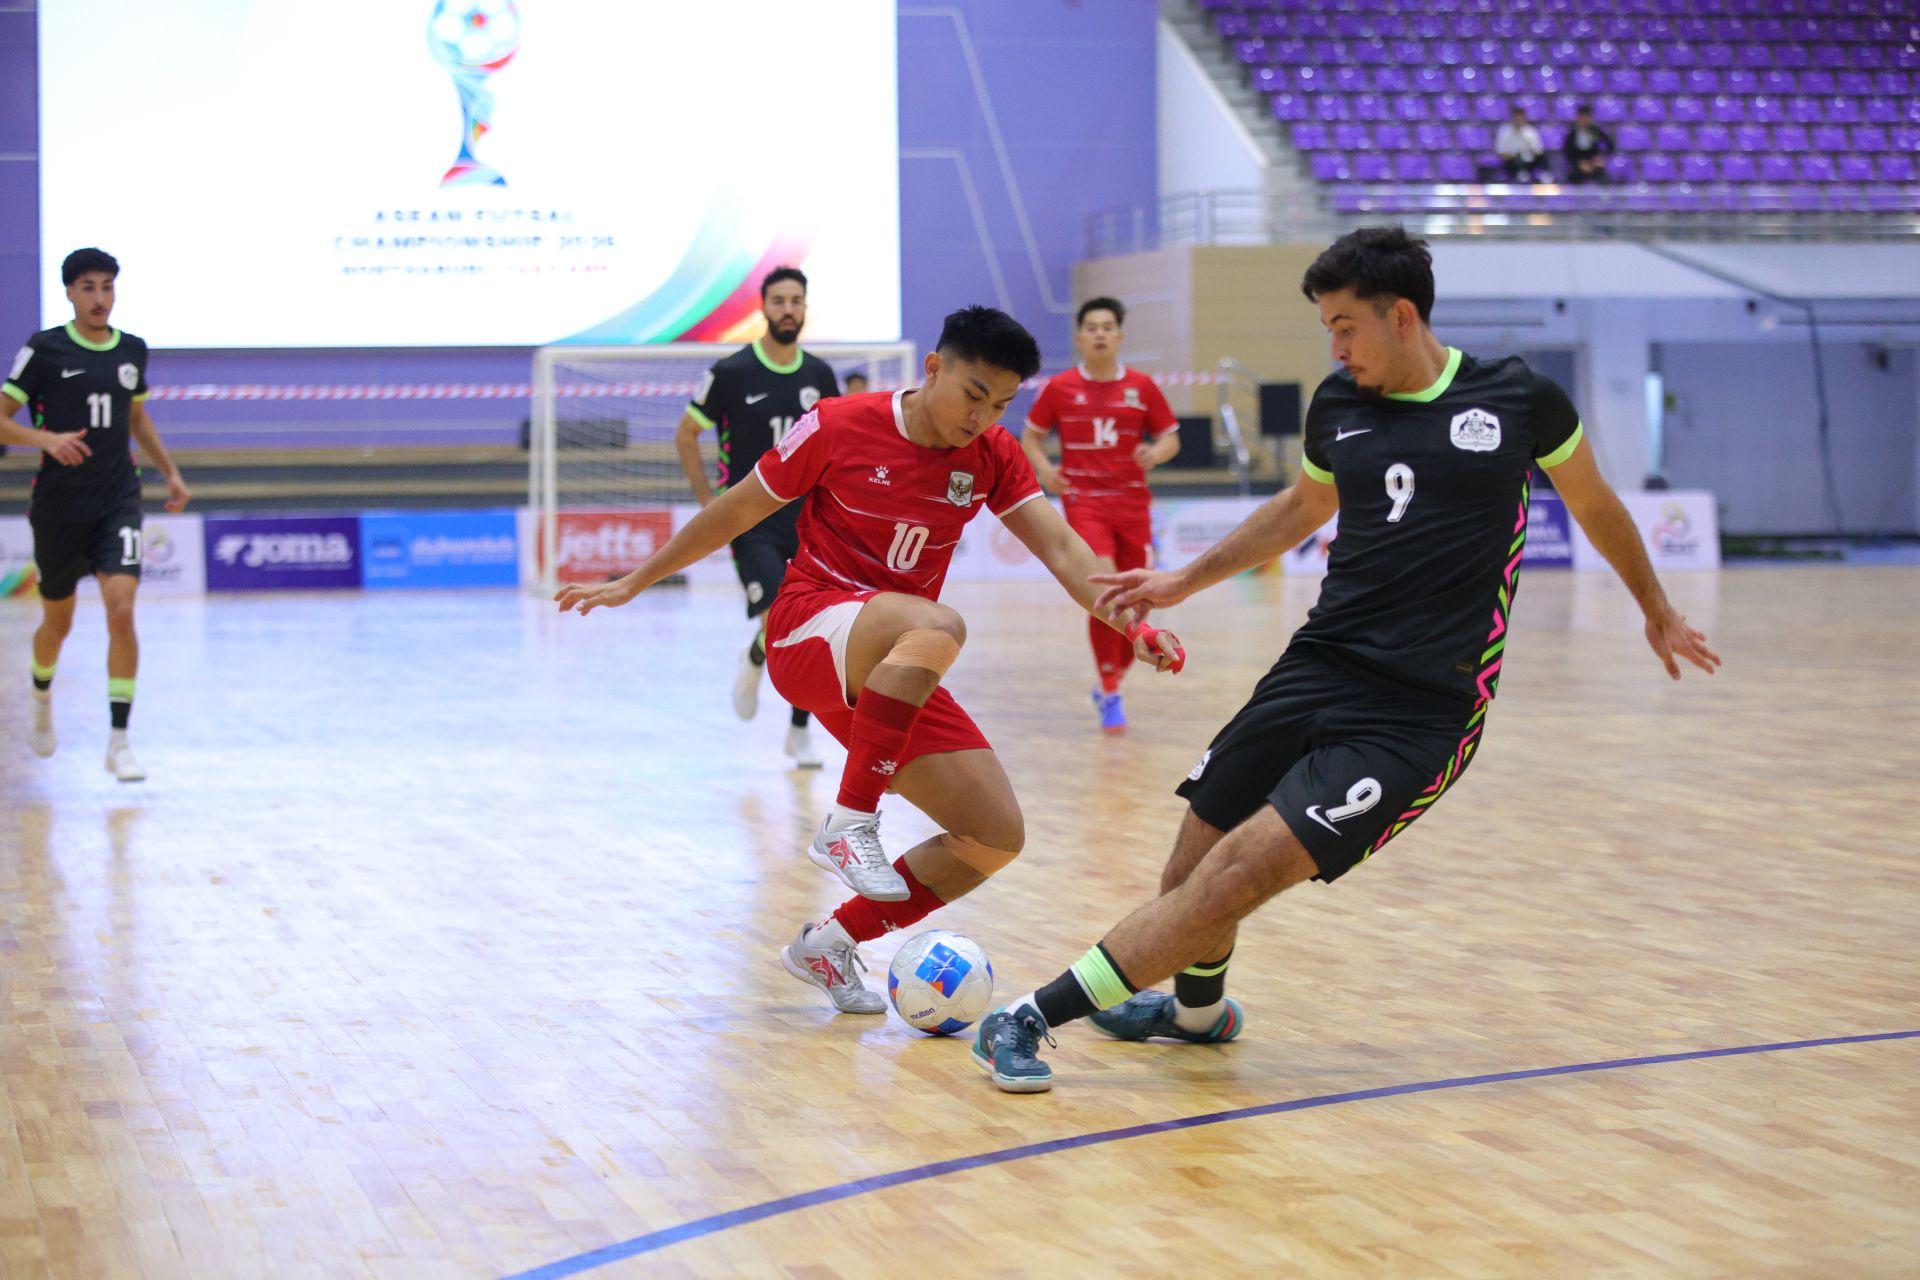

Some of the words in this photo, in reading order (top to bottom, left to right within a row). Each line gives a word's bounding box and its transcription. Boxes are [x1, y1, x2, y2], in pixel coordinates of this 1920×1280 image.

[86, 392, 112, 429] 11
[868, 476, 891, 487] KELME
[1384, 462, 1415, 523] 9
[886, 522, 930, 570] 10
[1325, 776, 1383, 823] 9
[910, 1007, 936, 1020] molten
